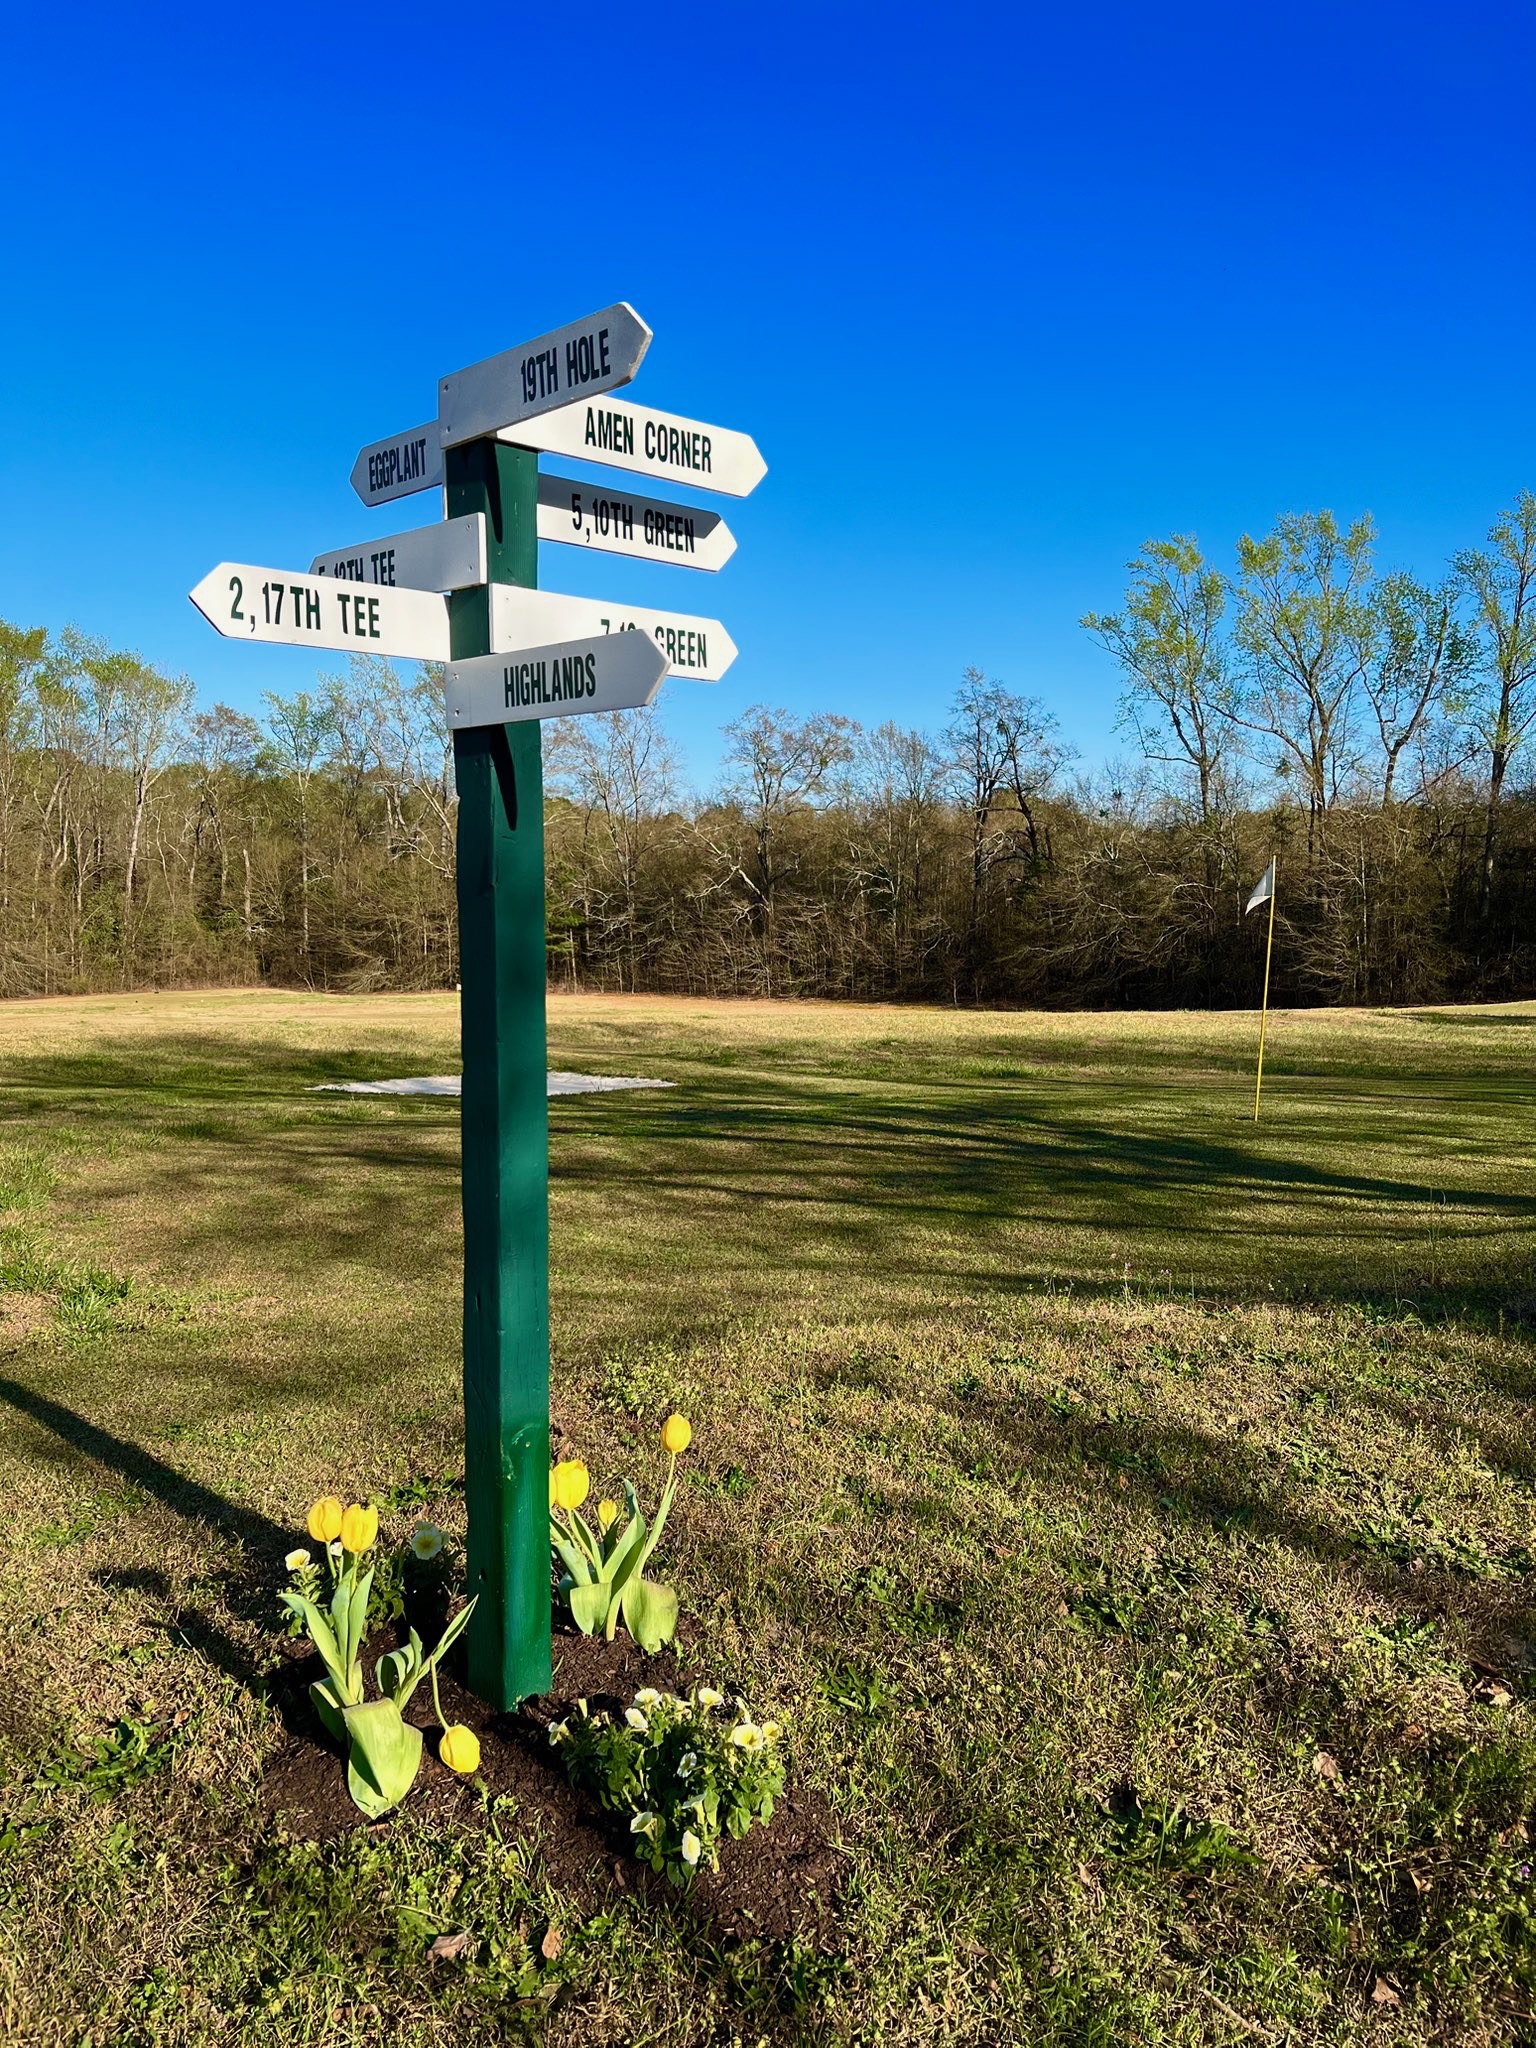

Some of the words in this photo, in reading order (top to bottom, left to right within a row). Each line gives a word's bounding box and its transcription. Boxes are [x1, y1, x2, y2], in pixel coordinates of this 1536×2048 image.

[521, 348, 559, 403] 19TH
[566, 328, 611, 388] HOLE
[368, 438, 426, 492] EGGPLANT
[584, 406, 634, 455] AMEN
[644, 421, 712, 473] CORNER
[571, 493, 634, 544] 5,10TH
[644, 509, 695, 553] GREEN
[370, 549, 396, 587] TEE
[229, 576, 321, 632] 2,17TH
[337, 593, 380, 638] TEE
[503, 652, 596, 708] HIGHLANDS
